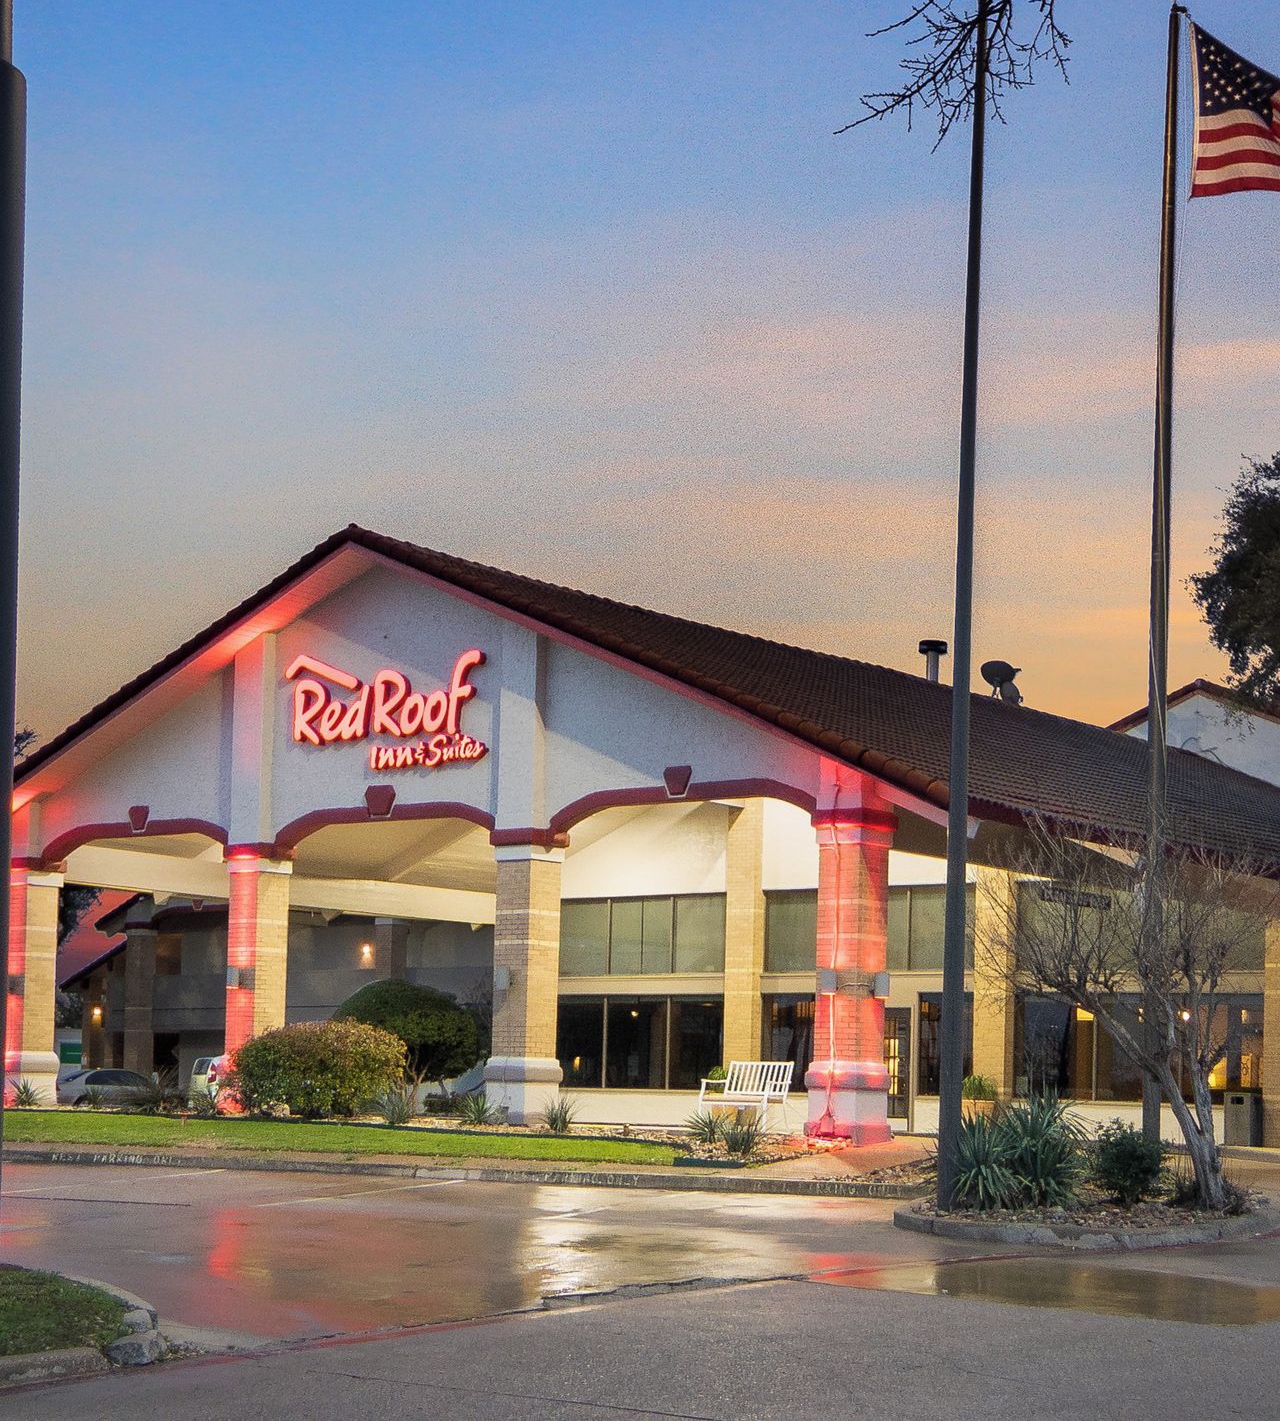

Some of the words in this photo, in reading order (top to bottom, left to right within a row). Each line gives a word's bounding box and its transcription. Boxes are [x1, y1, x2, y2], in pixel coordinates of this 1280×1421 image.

[293, 678, 370, 745] Red
[372, 649, 482, 738] Roof
[369, 745, 415, 769] Inn
[414, 741, 426, 764] &
[425, 733, 485, 767] Suites
